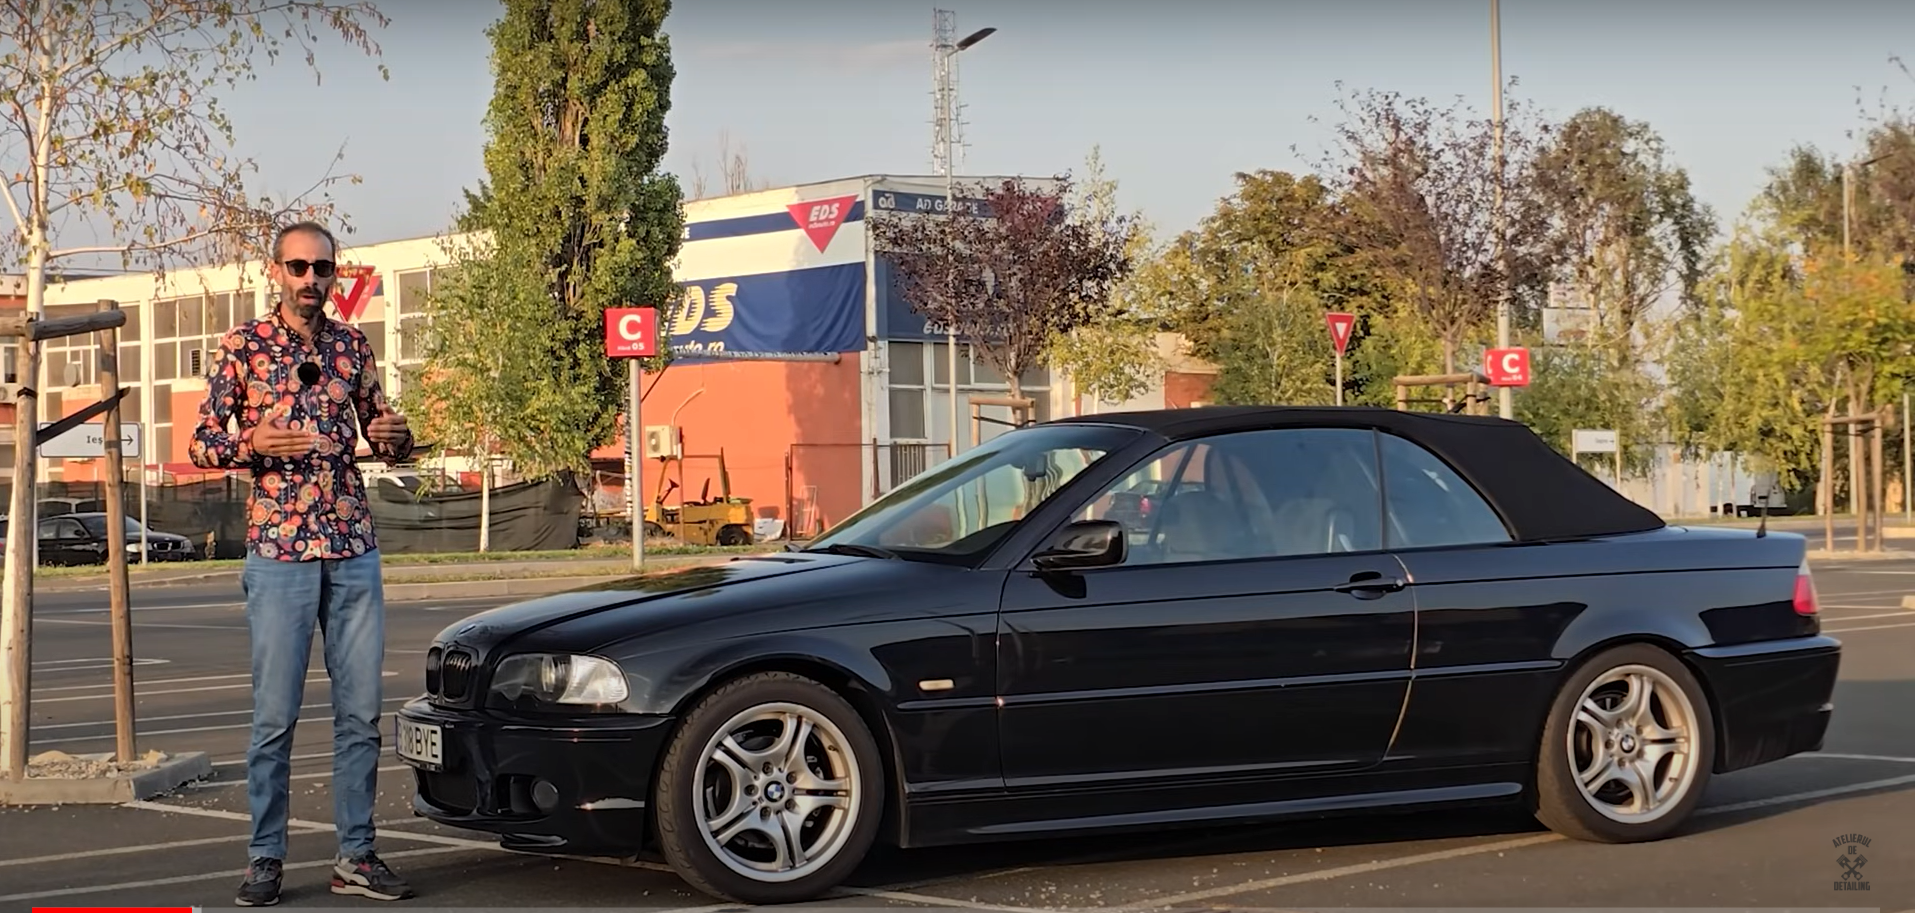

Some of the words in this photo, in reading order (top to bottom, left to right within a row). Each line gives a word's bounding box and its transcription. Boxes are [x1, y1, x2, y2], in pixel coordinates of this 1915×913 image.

[809, 203, 839, 221] EDS
[916, 198, 932, 210] AD
[660, 283, 738, 336] DS
[619, 314, 641, 340] C
[1502, 353, 1519, 373] C
[415, 727, 438, 758] BYE
